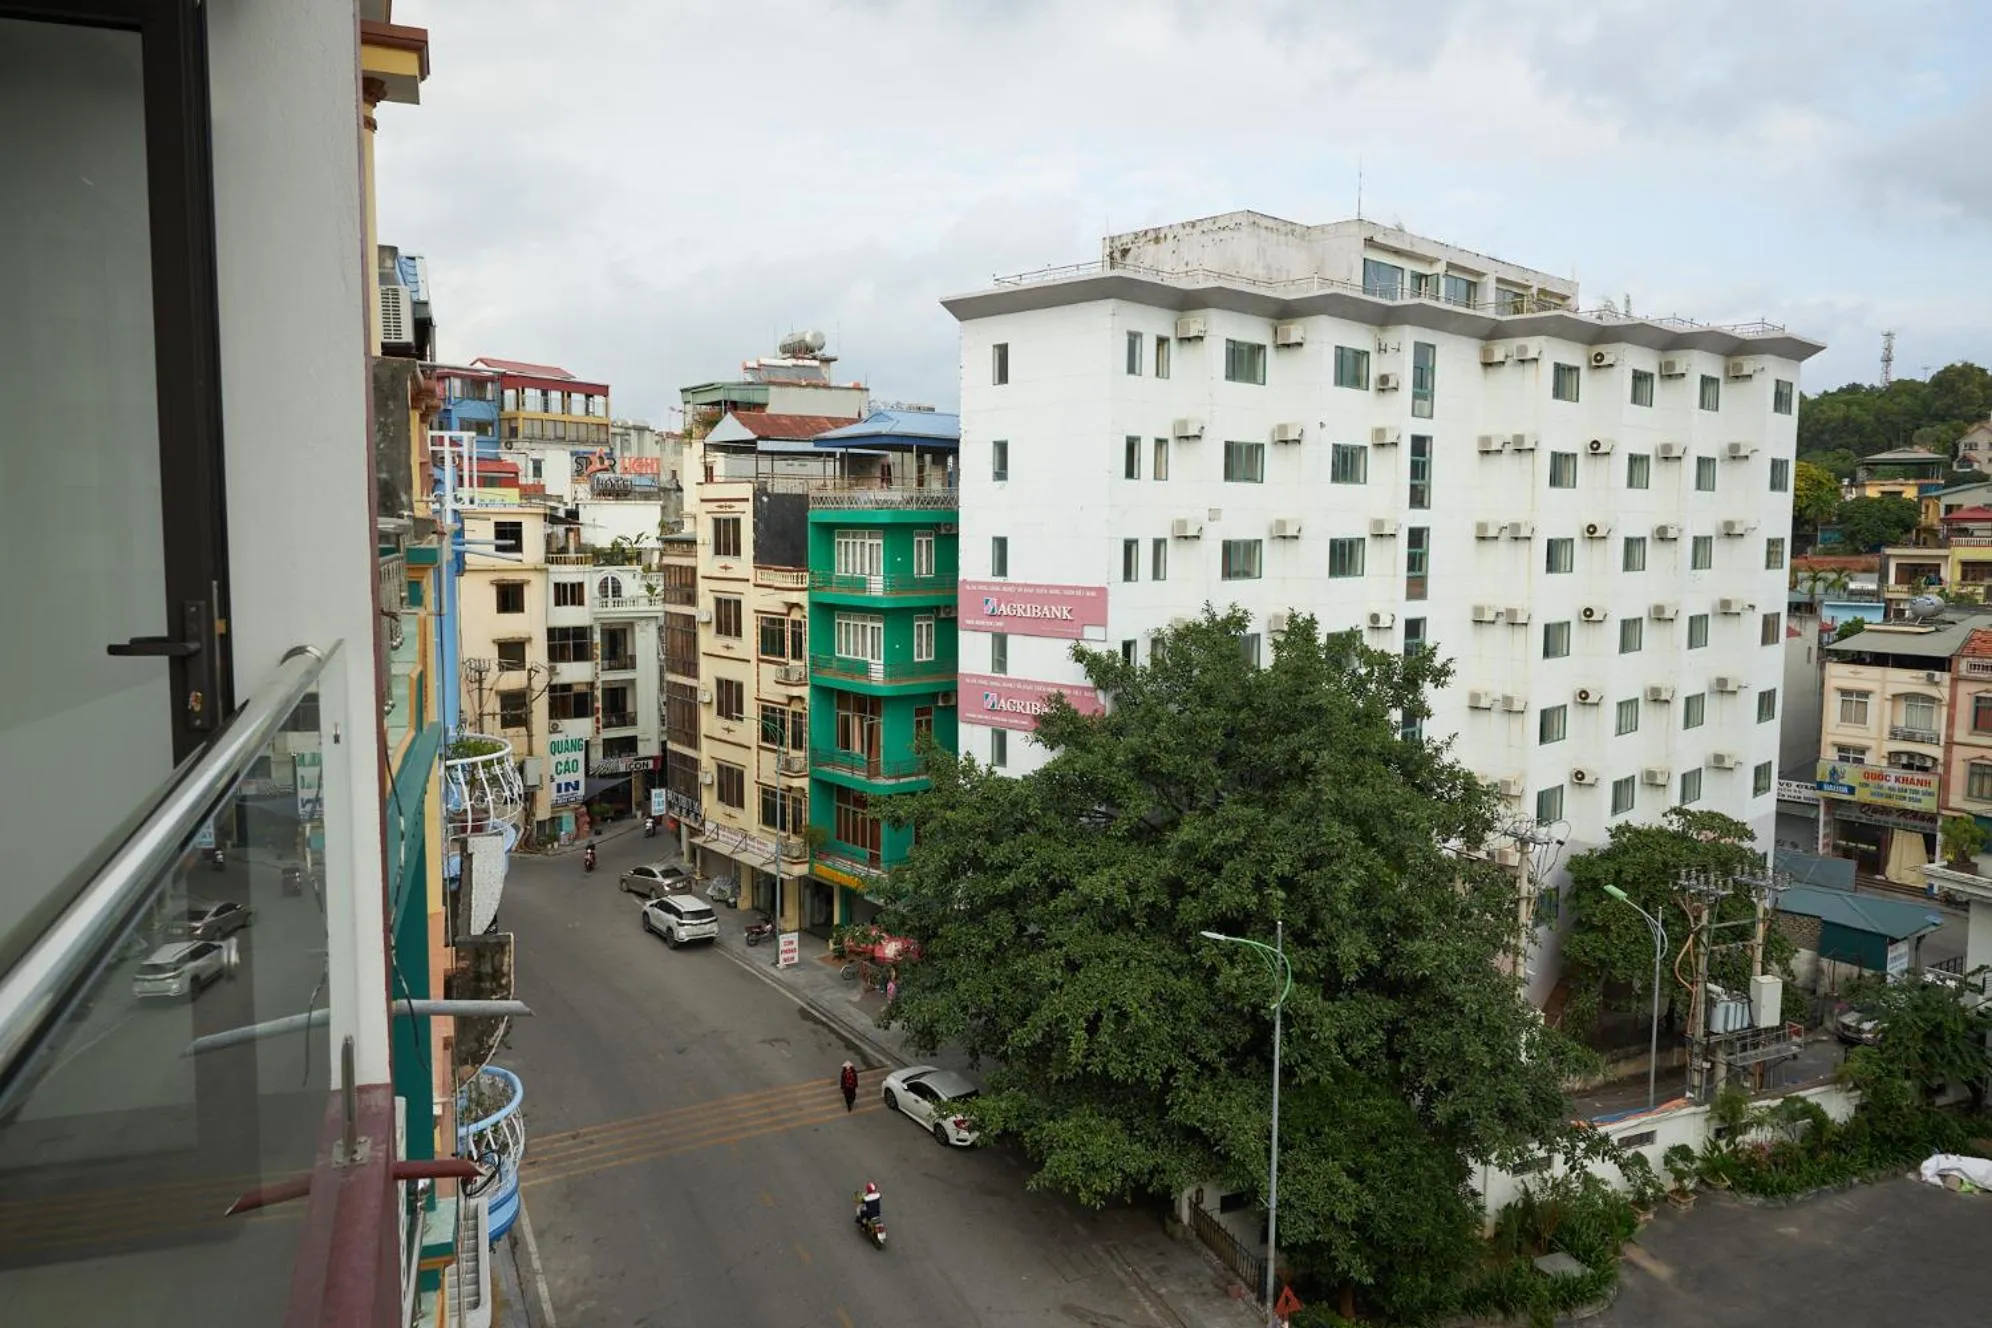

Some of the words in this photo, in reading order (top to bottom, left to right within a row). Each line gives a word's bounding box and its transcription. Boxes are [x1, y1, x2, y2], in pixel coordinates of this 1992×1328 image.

[998, 603, 1074, 620] AGRIBANK
[550, 735, 584, 756] QUẢNG
[555, 757, 579, 775] CÁO
[625, 760, 649, 770] ICON
[556, 780, 580, 793] IN
